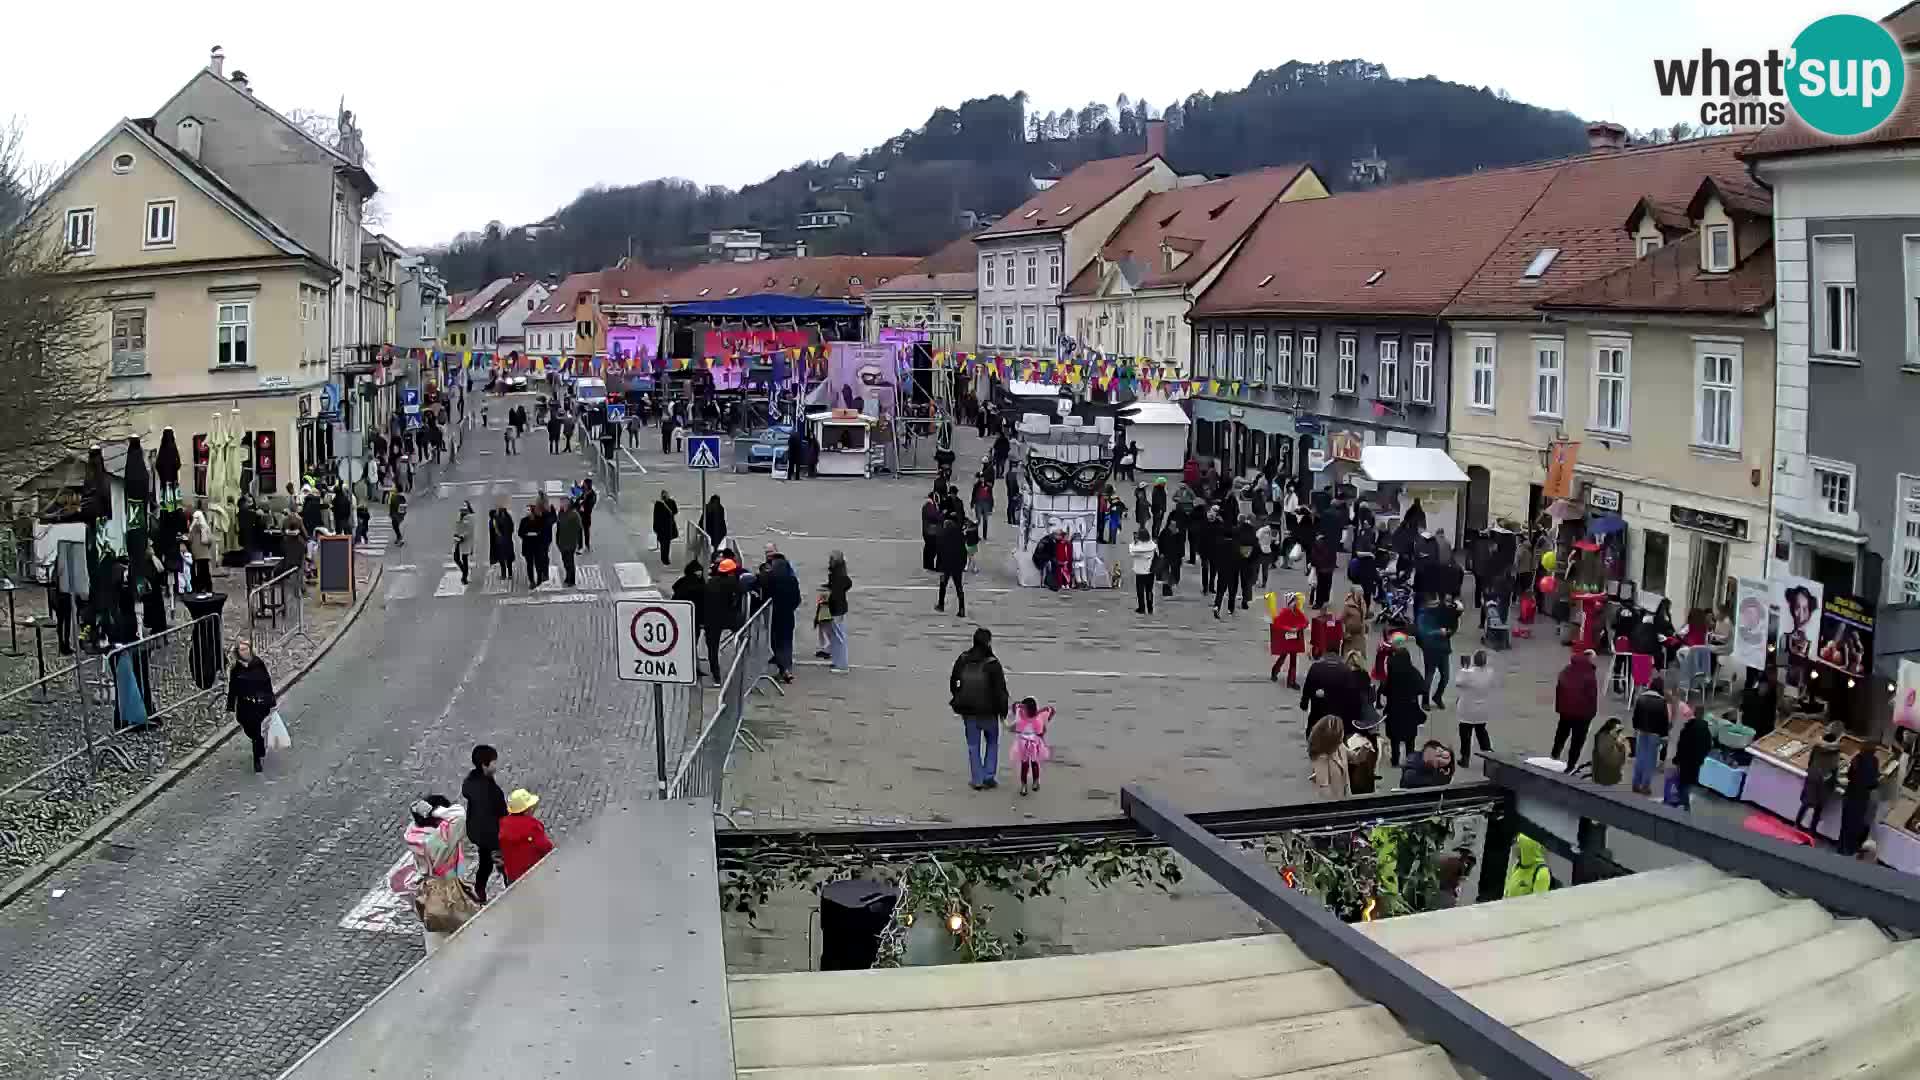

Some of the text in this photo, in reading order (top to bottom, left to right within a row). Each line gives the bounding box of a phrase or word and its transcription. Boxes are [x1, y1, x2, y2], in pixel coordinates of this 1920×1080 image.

[407, 391, 416, 402] P
[643, 622, 667, 643] 30
[634, 659, 678, 677] ZONA
